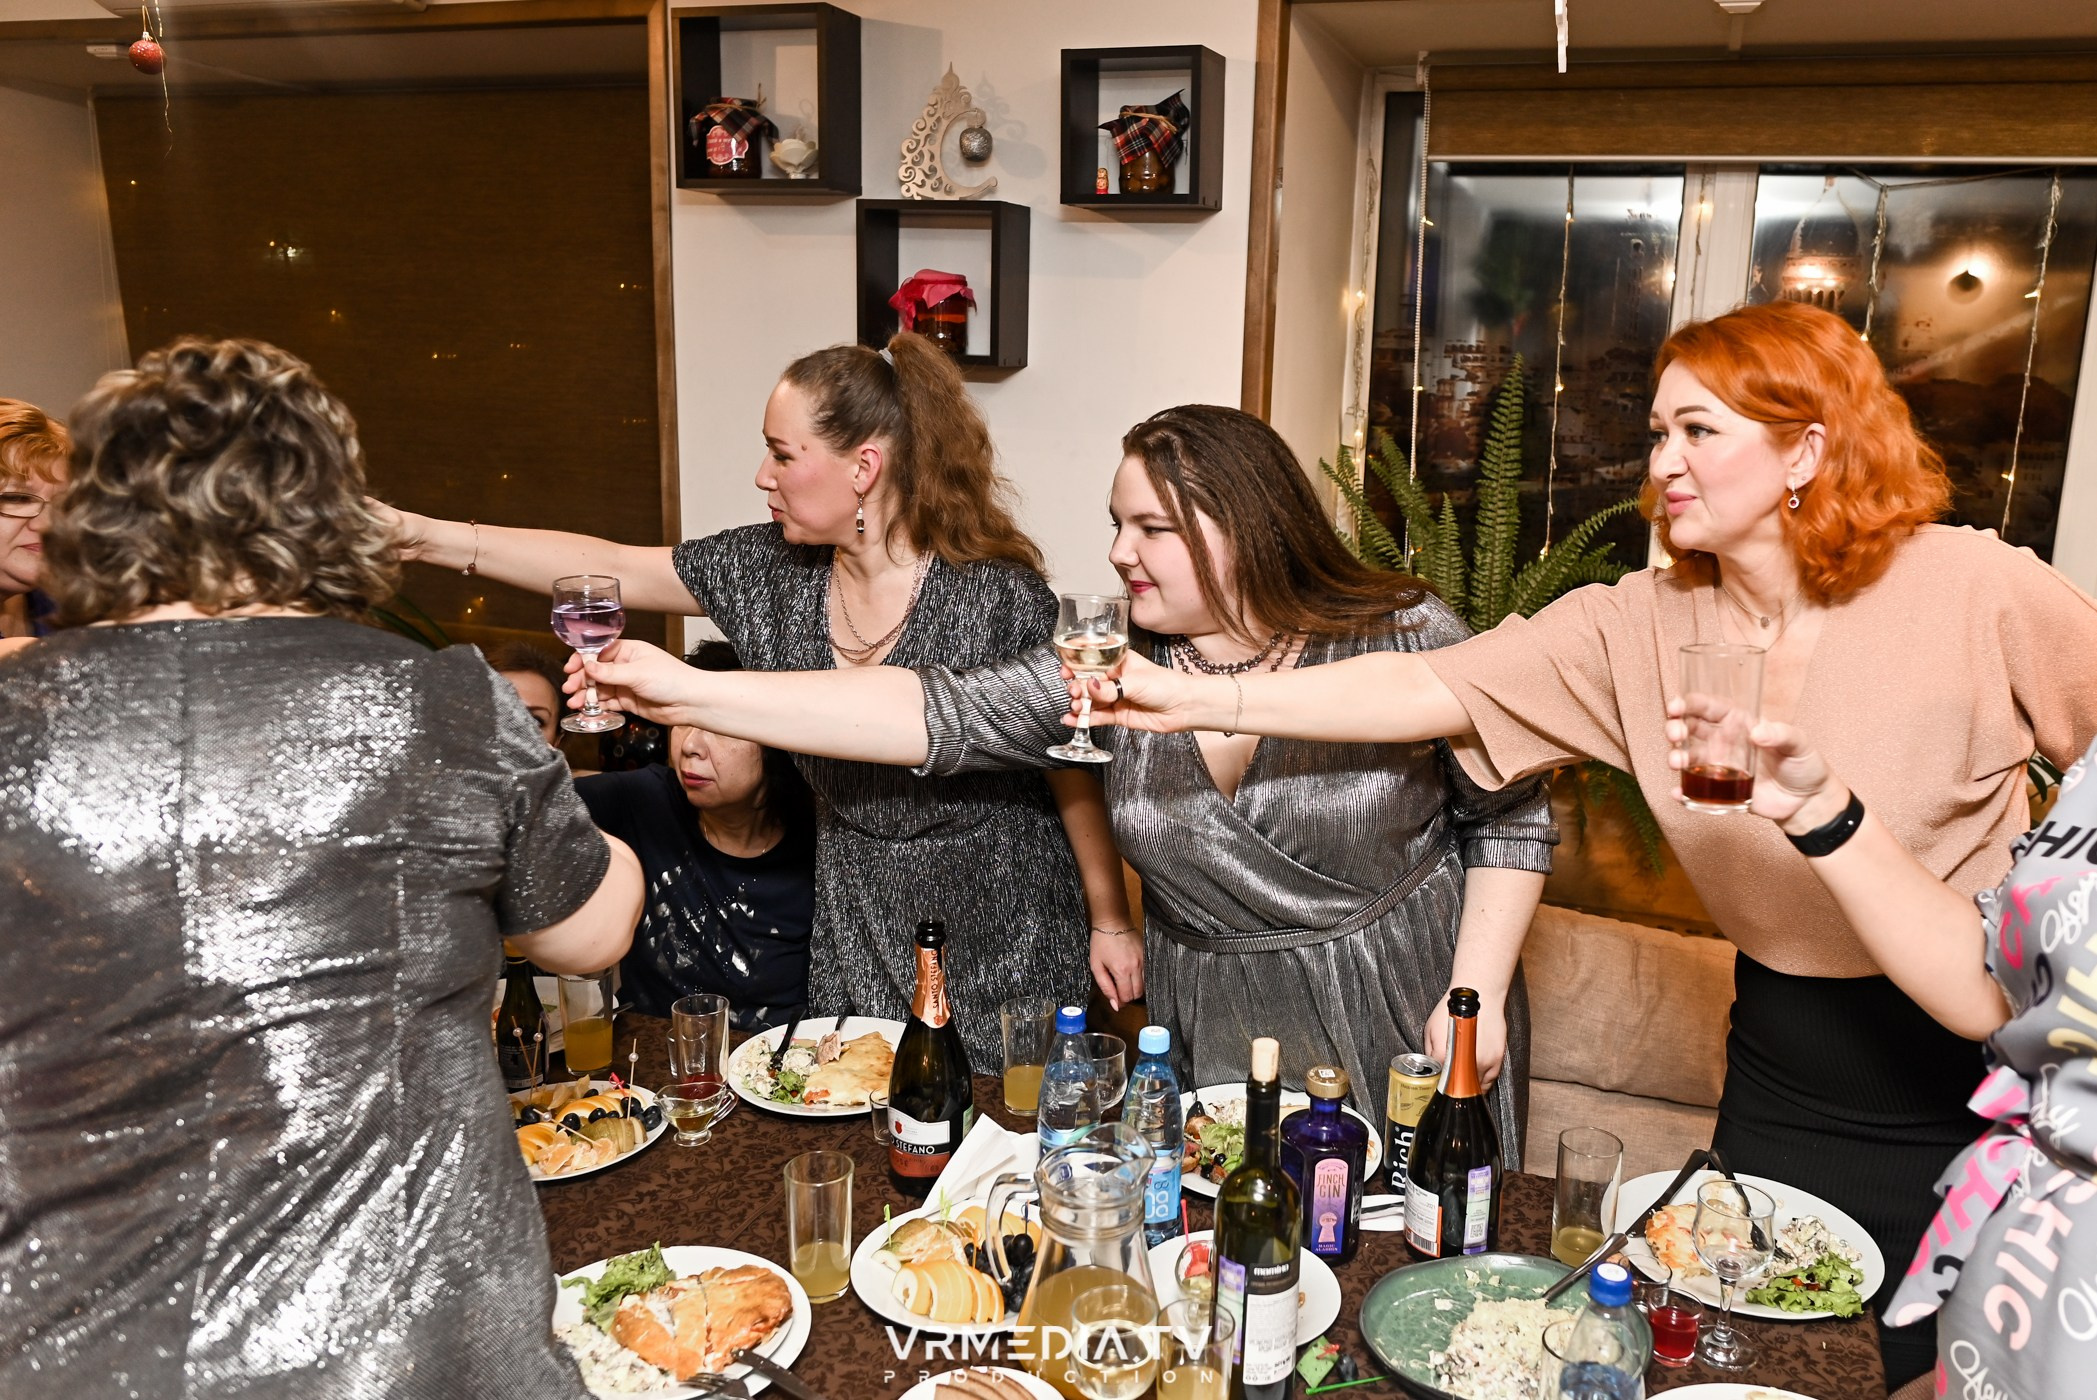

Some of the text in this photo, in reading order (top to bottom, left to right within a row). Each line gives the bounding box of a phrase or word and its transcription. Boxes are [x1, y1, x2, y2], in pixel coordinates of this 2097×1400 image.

[932, 984, 940, 1009] SANTO
[896, 1139, 935, 1155] STEFANO
[1391, 1131, 1414, 1190] Rich
[1317, 1173, 1345, 1188] FINCH
[1320, 1185, 1341, 1198] GIN
